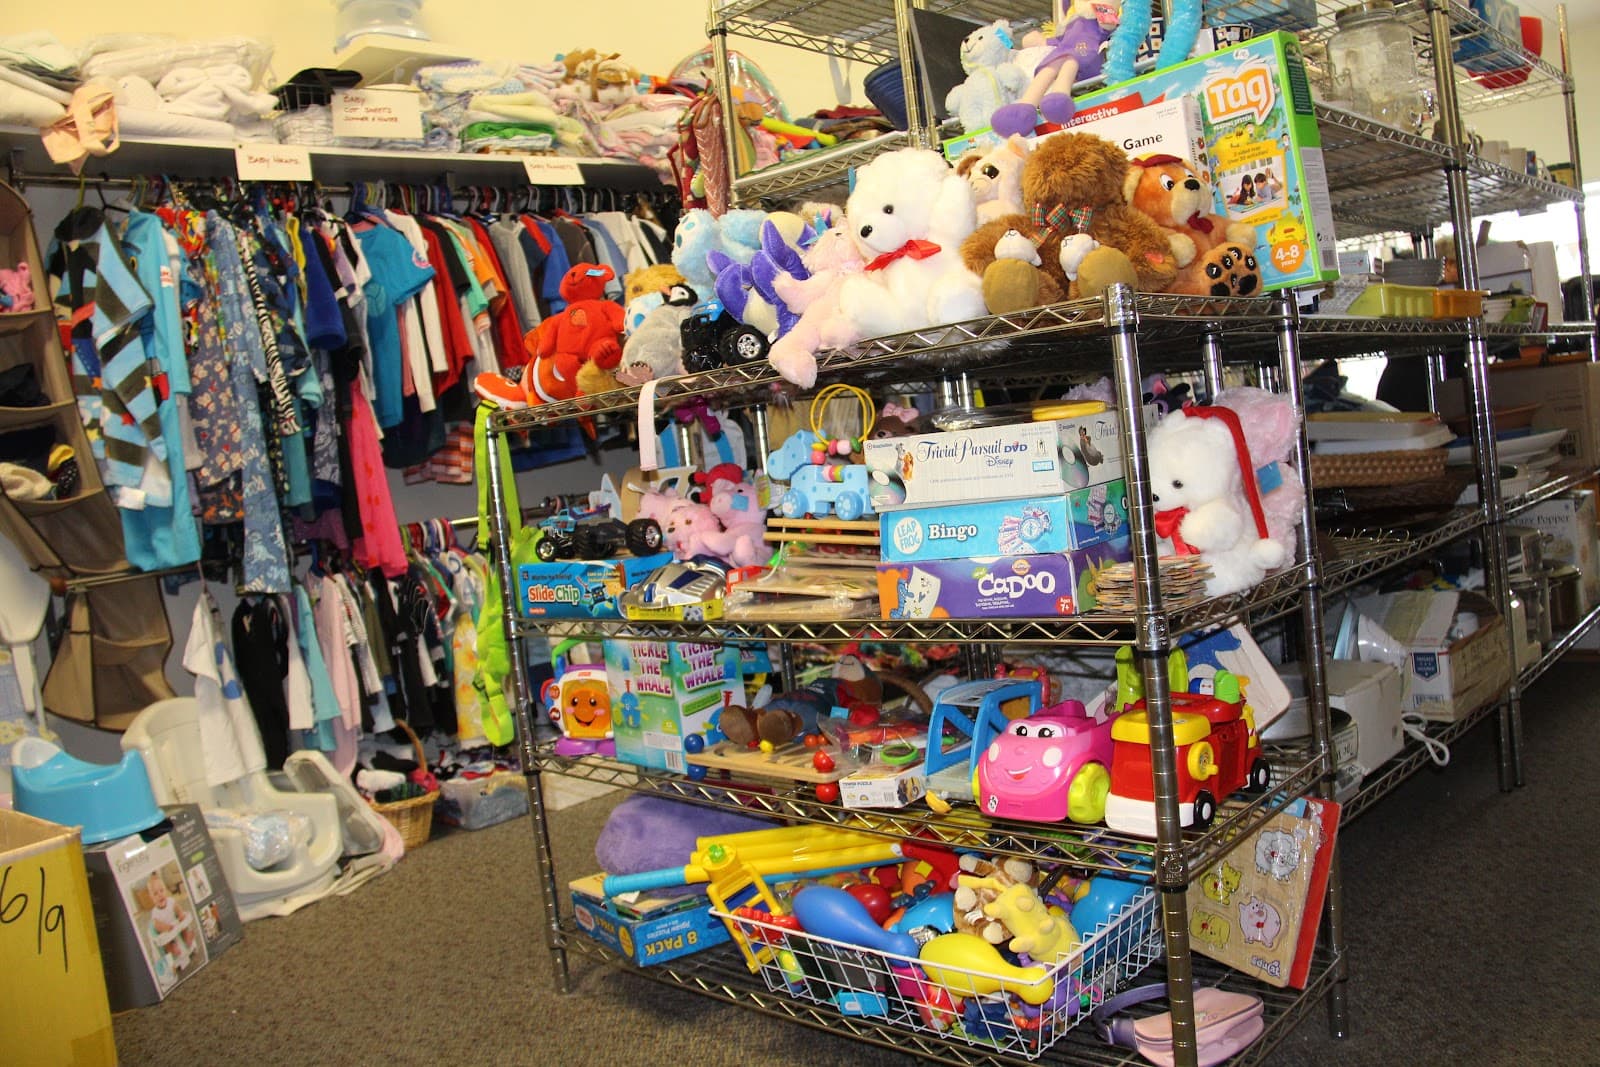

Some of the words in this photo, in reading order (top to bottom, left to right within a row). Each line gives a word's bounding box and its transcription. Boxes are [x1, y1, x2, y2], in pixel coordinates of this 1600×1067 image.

[1210, 74, 1269, 113] Tag
[1123, 133, 1164, 151] Game
[1274, 244, 1301, 261] 4-8
[916, 440, 959, 463] Trivial
[954, 435, 1003, 465] Pursuit
[1003, 443, 1028, 454] DVD
[986, 455, 1014, 468] Disney
[896, 519, 918, 539] LEAP
[928, 523, 977, 542] Bingo
[899, 533, 921, 551] FROG
[1061, 603, 1070, 612] 7+
[630, 642, 668, 659] TICKLE
[640, 660, 661, 675] THE
[689, 655, 714, 671] THE
[636, 679, 671, 695] WHALE
[684, 668, 724, 690] WHALE
[644, 934, 684, 957] PACK
[686, 931, 698, 944] 8
